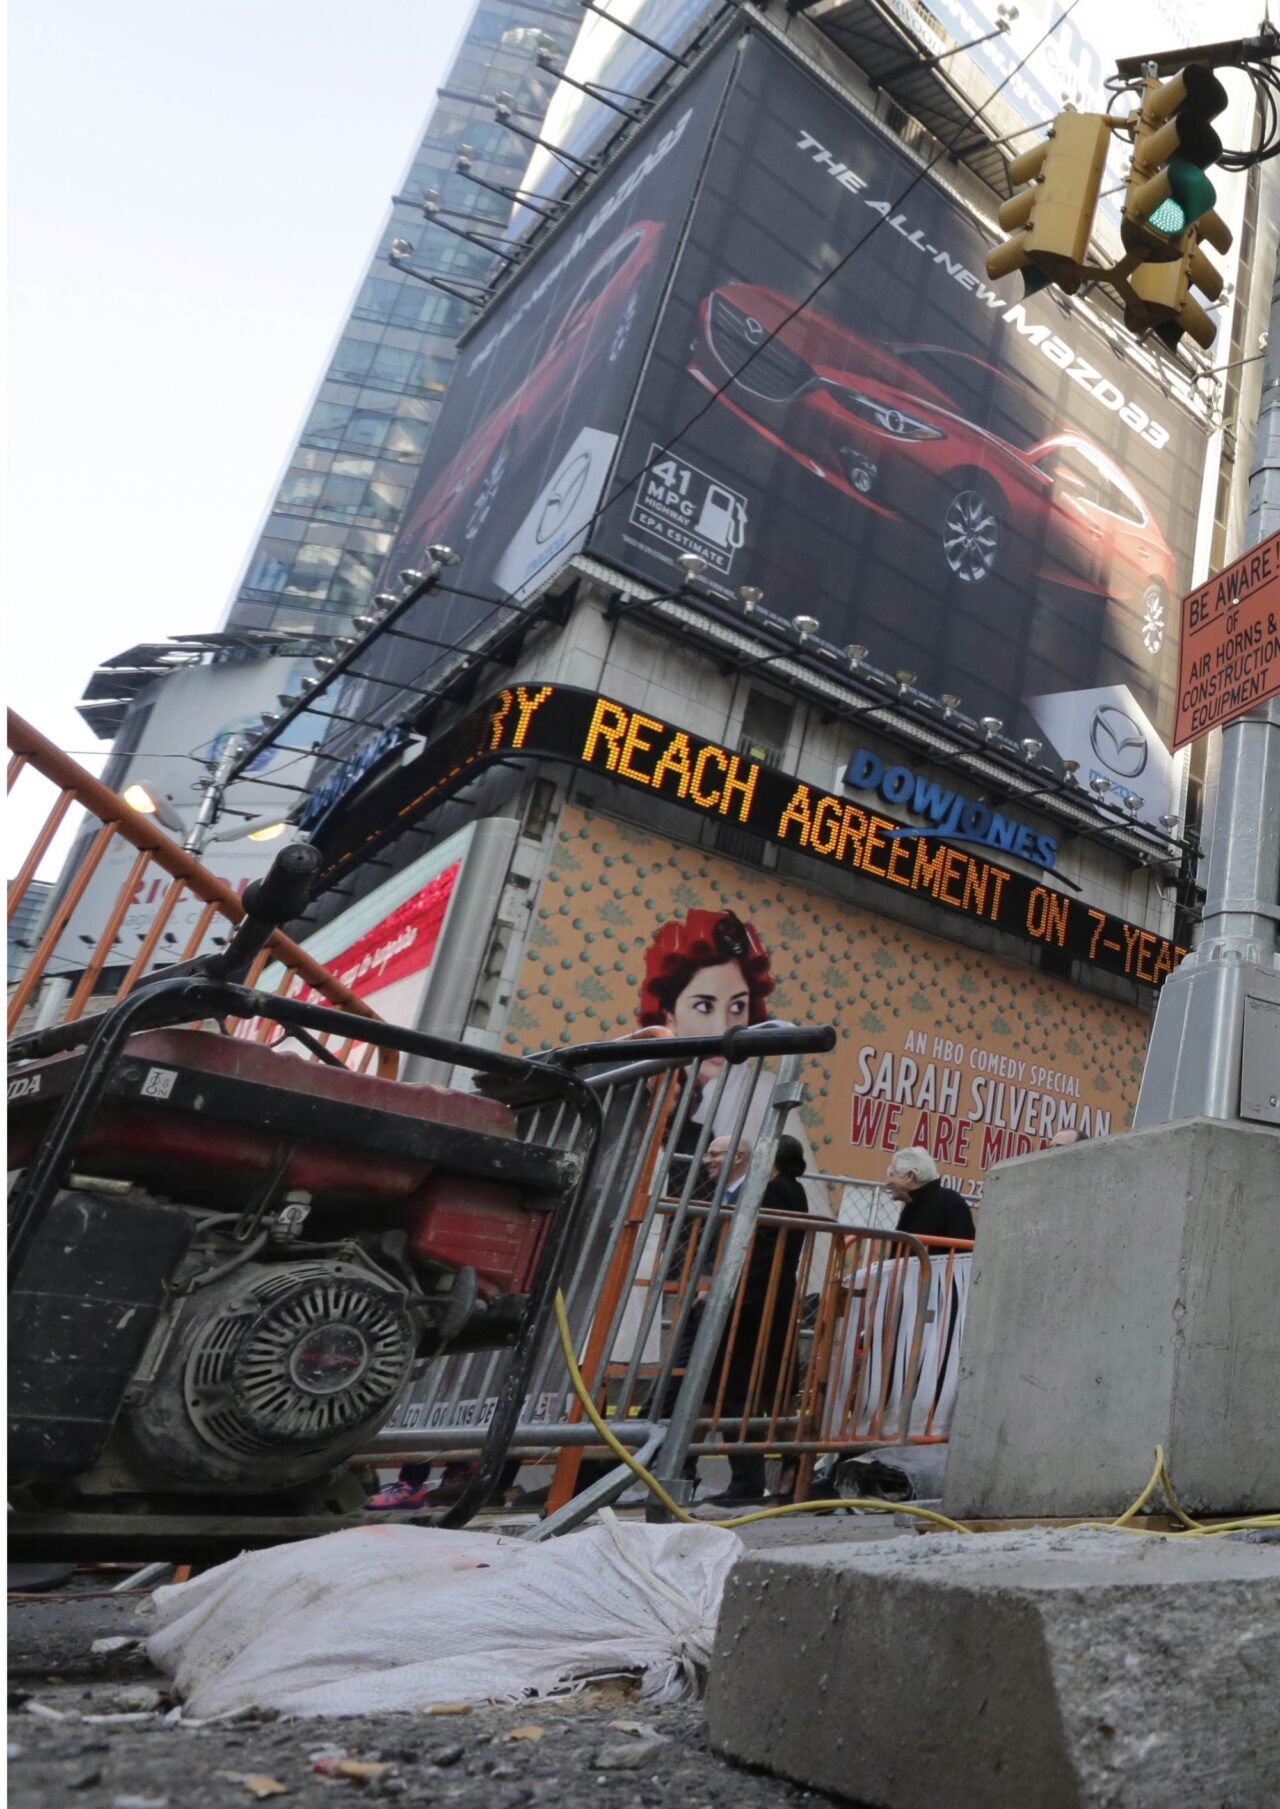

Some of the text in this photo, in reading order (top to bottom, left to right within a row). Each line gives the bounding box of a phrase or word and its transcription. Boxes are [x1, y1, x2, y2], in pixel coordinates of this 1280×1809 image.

[796, 130, 1007, 310] THE ALL-NEW
[644, 496, 691, 526] HIGHWAY
[647, 481, 697, 516] MPG
[652, 460, 691, 496] 41
[639, 513, 663, 533] EPA
[667, 526, 724, 566] ESTIMATE
[1189, 541, 1280, 629] BE AWARE!
[1189, 612, 1277, 685] AIR HORNS &
[1226, 610, 1239, 635] OF
[1191, 668, 1269, 732] EQUIPMENT
[581, 698, 760, 824] REACH
[777, 784, 1012, 921] AGREEMENT
[1025, 886, 1070, 948] ON
[854, 1046, 1111, 1139] SARAH SILVERMAN
[904, 1029, 1082, 1099] AN HBO COMEDY SPECIAL
[851, 1094, 903, 1153] WE
[911, 1109, 973, 1167] ARE
